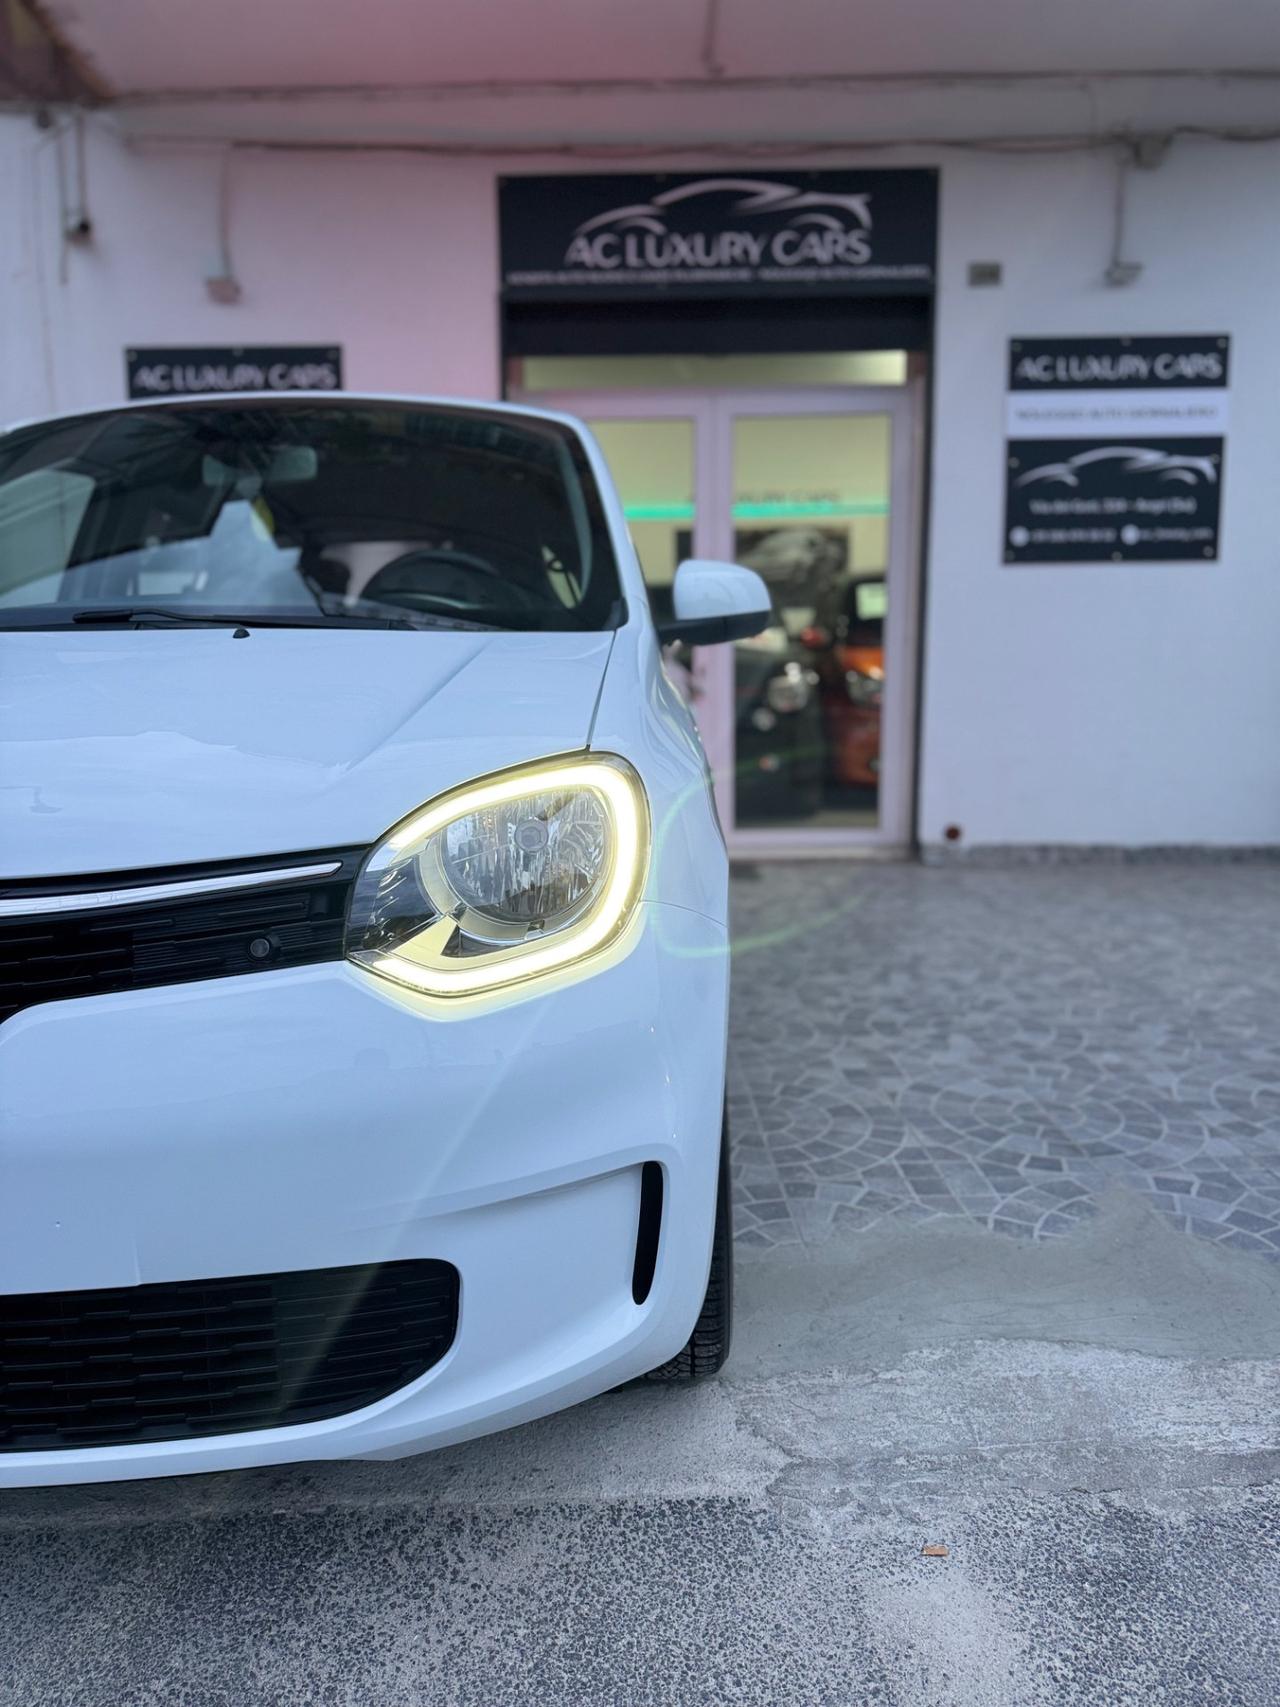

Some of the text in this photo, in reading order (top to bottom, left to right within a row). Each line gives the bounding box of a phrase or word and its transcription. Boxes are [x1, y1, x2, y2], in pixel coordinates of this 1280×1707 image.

[564, 229, 872, 268] AC LUXURY CARS
[134, 362, 338, 392] AC LUXURY CARS
[1015, 352, 1223, 382] AC LUXURY CARS
